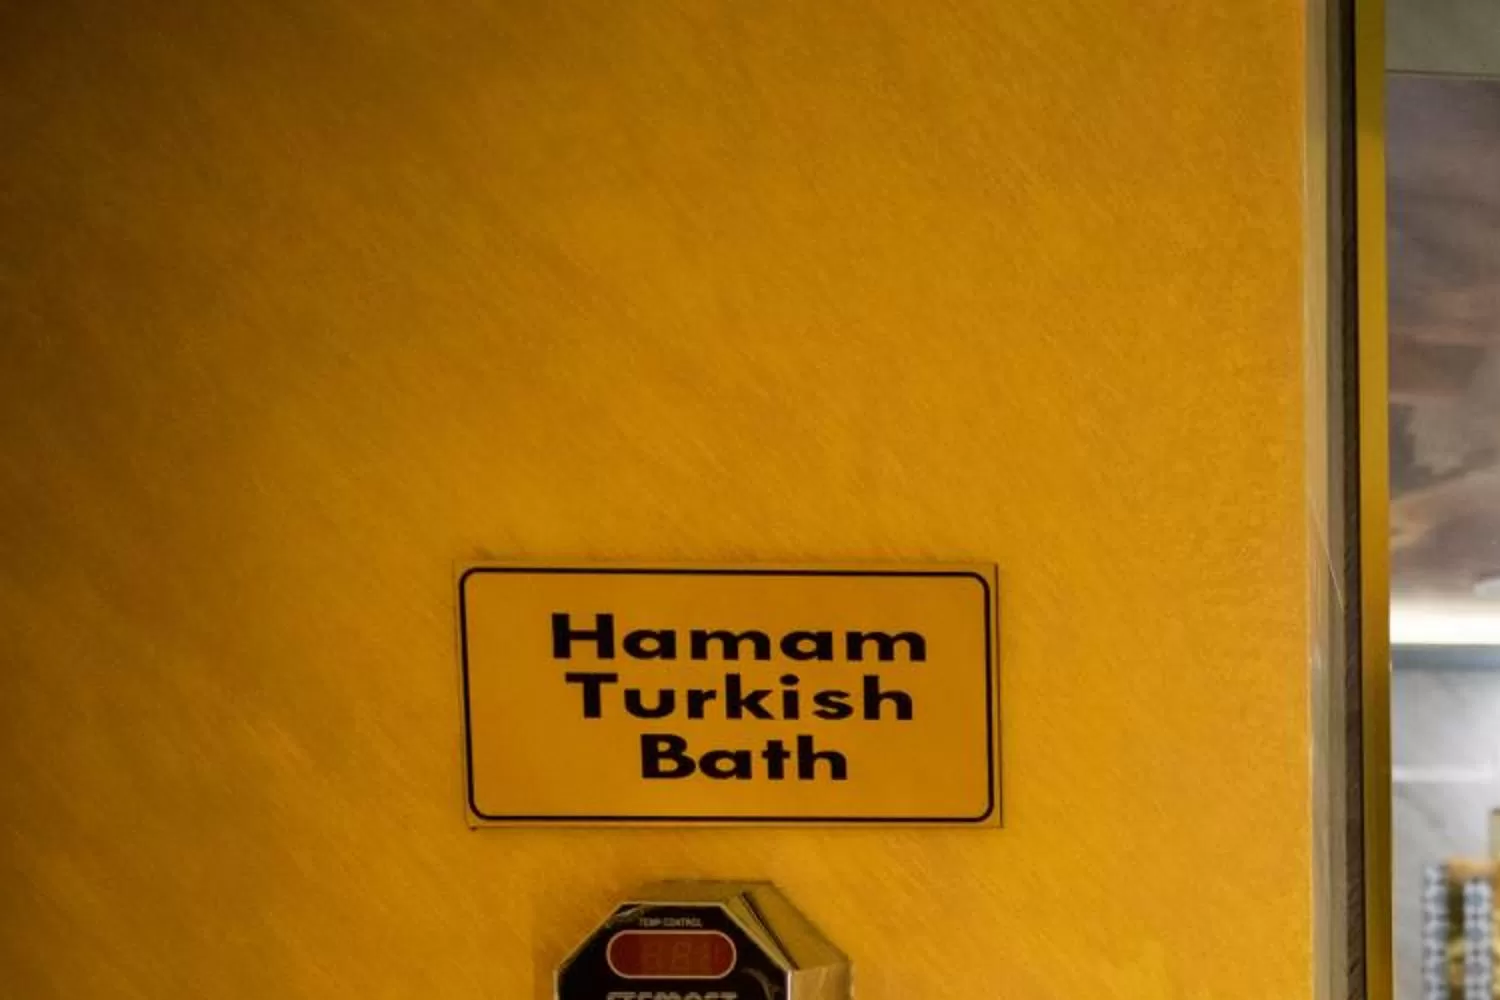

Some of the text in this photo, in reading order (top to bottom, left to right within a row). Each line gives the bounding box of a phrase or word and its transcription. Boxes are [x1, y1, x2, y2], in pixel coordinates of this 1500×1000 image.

[551, 612, 927, 662] Hamam
[565, 672, 914, 721] Turkish
[640, 733, 848, 780] Bath
